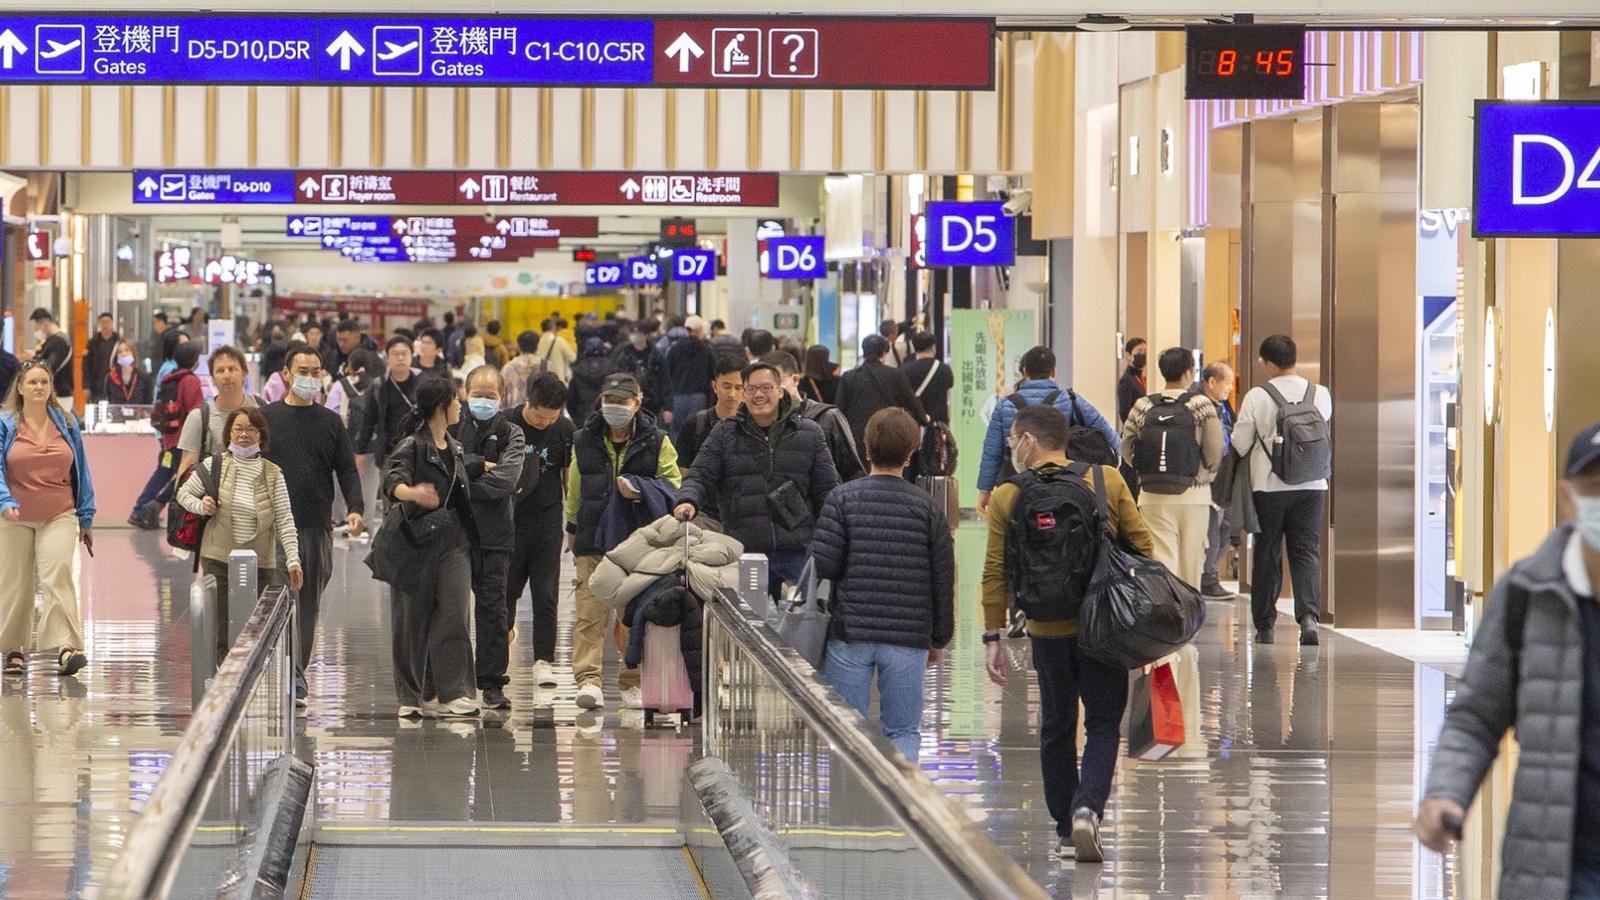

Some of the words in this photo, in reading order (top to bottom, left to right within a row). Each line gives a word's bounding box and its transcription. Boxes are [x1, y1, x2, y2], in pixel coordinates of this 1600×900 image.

[92, 25, 180, 54] 登機門
[430, 26, 518, 56] 登機門
[187, 39, 310, 63] D5-D10,D5R
[524, 41, 645, 64] C1-C10,C5R
[93, 57, 147, 75] Gates
[431, 59, 484, 77] Gates
[188, 174, 231, 190] 登機門
[233, 181, 272, 193] D6-D10
[349, 175, 393, 191] 祈禱室
[510, 175, 539, 191] 餐飲
[696, 176, 741, 193] 洗手間
[188, 190, 216, 201] Gates
[509, 191, 557, 202] Restaurant
[695, 192, 741, 203] Restroom
[941, 215, 997, 253] D5
[678, 255, 708, 276] D7
[777, 244, 817, 271] D6
[598, 266, 621, 283] D9
[632, 261, 658, 280] D8
